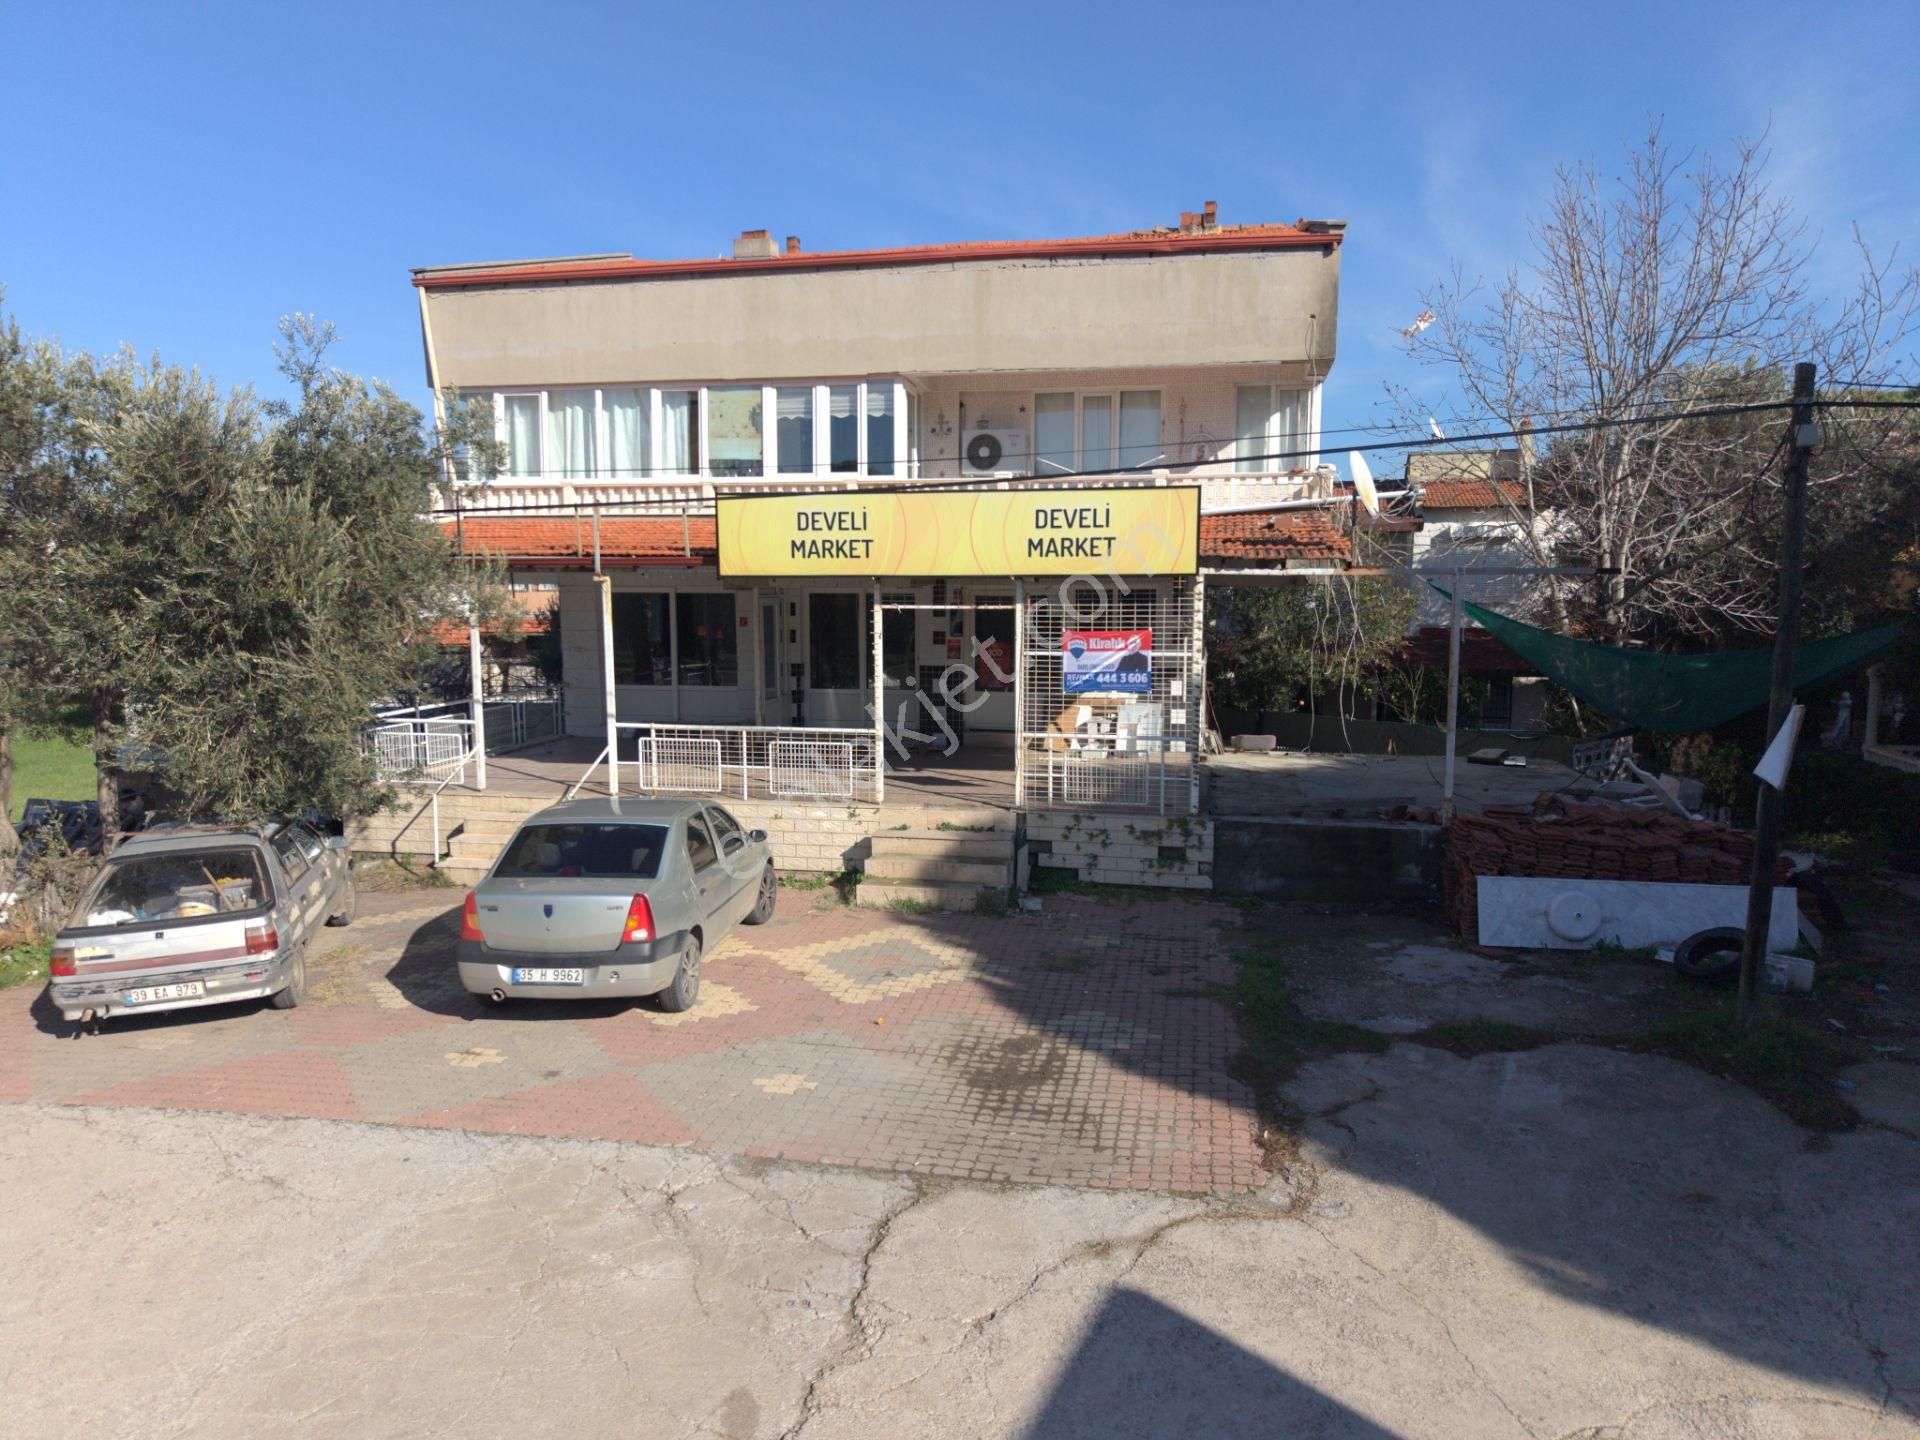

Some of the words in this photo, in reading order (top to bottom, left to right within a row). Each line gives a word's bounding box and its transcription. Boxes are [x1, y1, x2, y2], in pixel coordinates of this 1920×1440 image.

[797, 506, 867, 531] DEVELİ
[1035, 502, 1110, 529] DEVELİ
[791, 539, 874, 559] MARKET
[1028, 537, 1117, 557] MARKET
[1096, 673, 1118, 684] 444
[520, 969, 534, 981] 35
[540, 969, 548, 981] H
[553, 969, 581, 981] 9962
[133, 990, 148, 1002] 39
[154, 987, 169, 999] EA
[176, 983, 198, 997] 979
